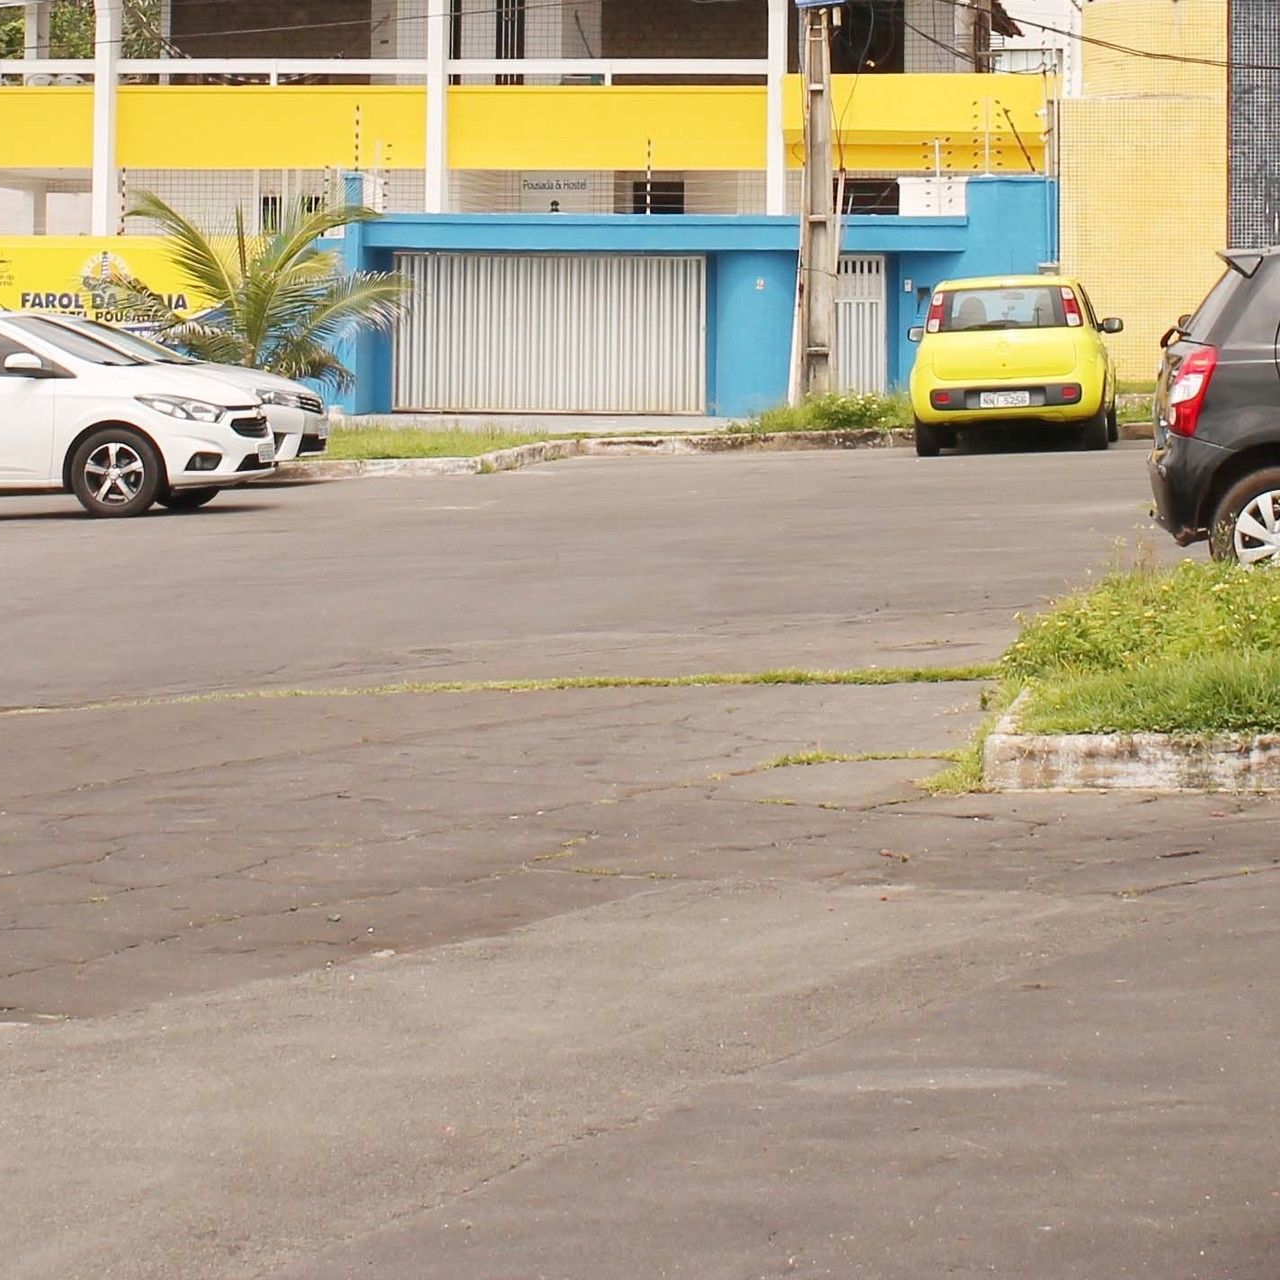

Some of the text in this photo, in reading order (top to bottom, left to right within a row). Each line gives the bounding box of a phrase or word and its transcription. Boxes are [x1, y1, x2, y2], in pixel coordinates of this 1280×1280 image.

[523, 179, 587, 190] Pousada & Hostel
[21, 293, 84, 309] FAROL
[92, 293, 120, 309] DA
